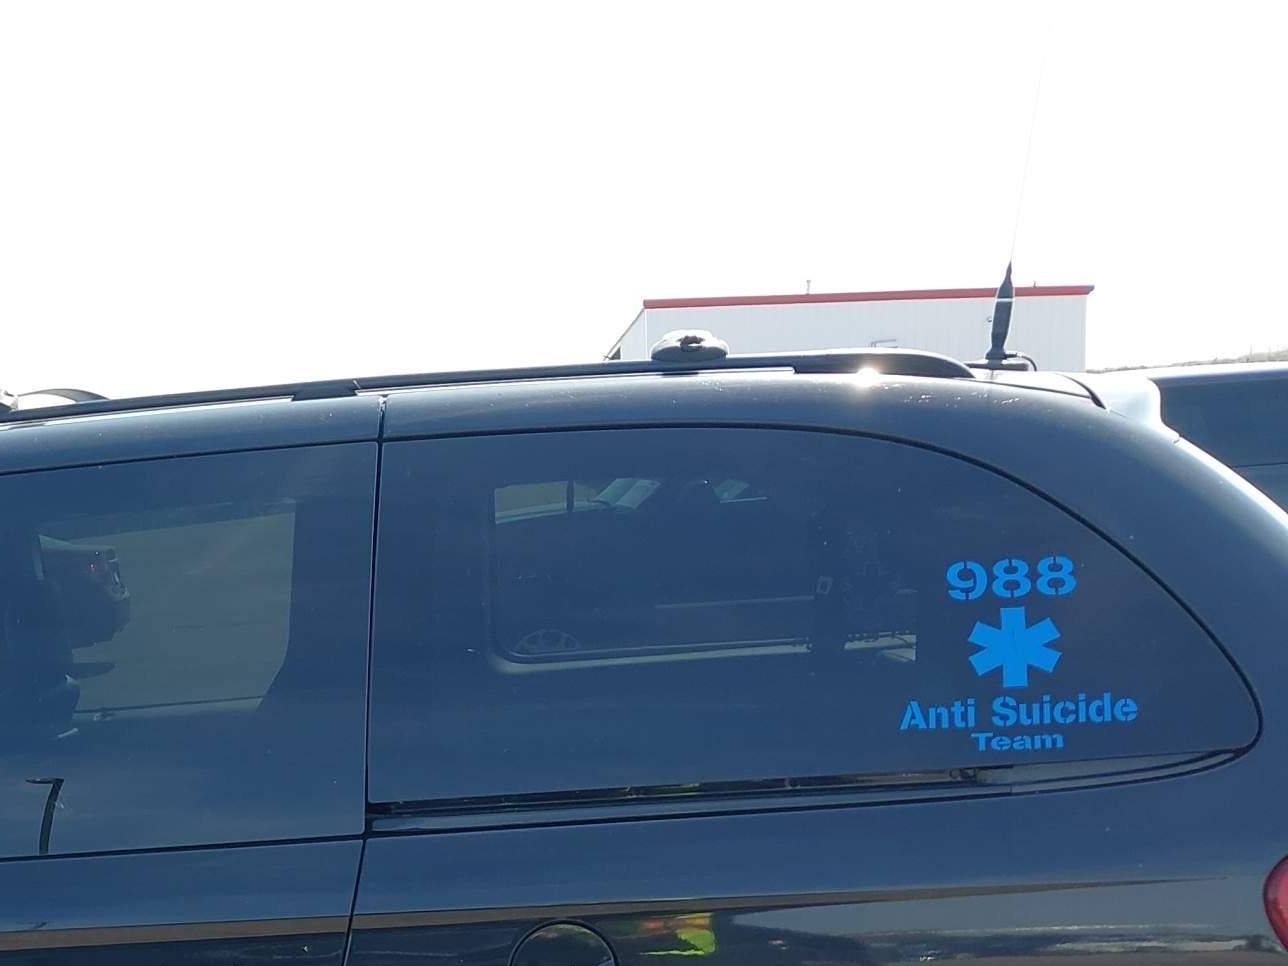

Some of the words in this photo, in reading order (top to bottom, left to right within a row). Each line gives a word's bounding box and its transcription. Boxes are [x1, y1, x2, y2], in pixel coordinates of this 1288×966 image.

[946, 556, 1077, 600] 988
[899, 698, 976, 731] Anti
[991, 692, 1139, 728] Suicide
[971, 731, 1064, 751] Team
